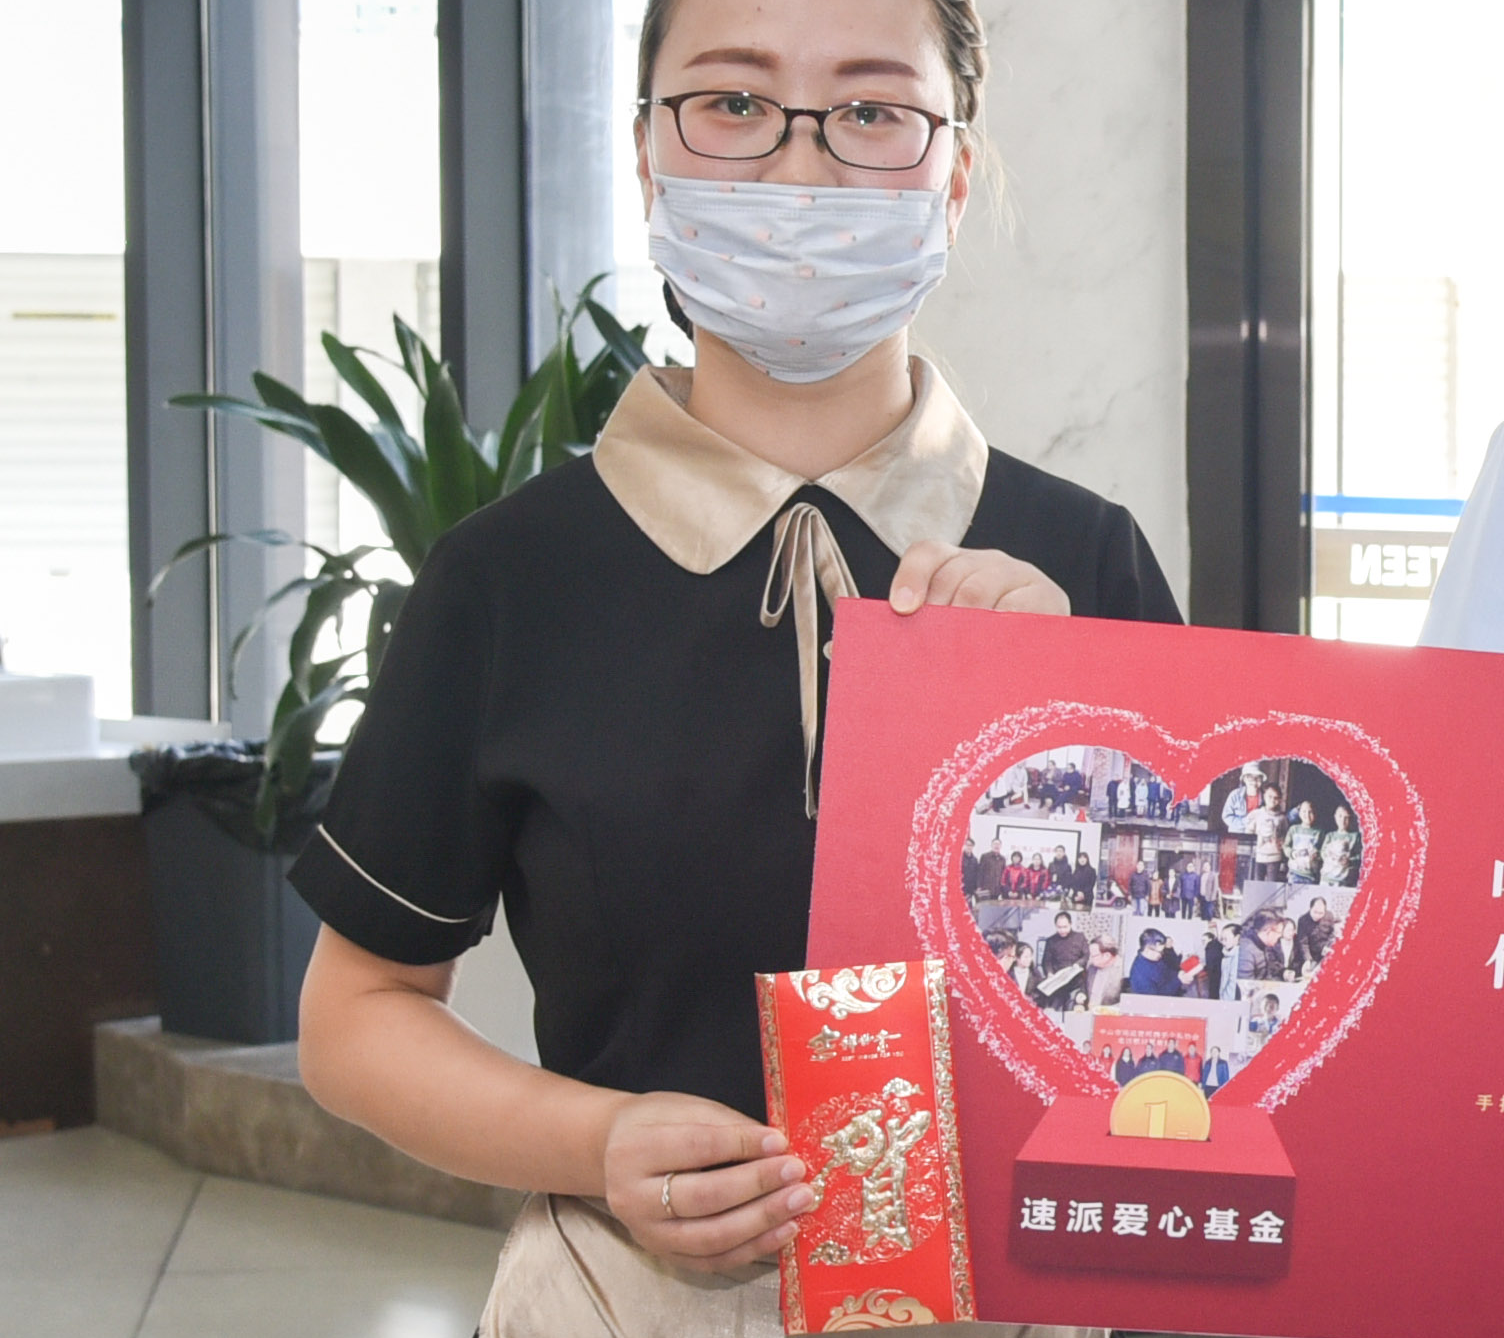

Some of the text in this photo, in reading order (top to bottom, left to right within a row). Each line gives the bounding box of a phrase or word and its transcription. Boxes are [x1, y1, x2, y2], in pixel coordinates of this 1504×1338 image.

[1020, 1196, 1285, 1244] 速派爱心基金
